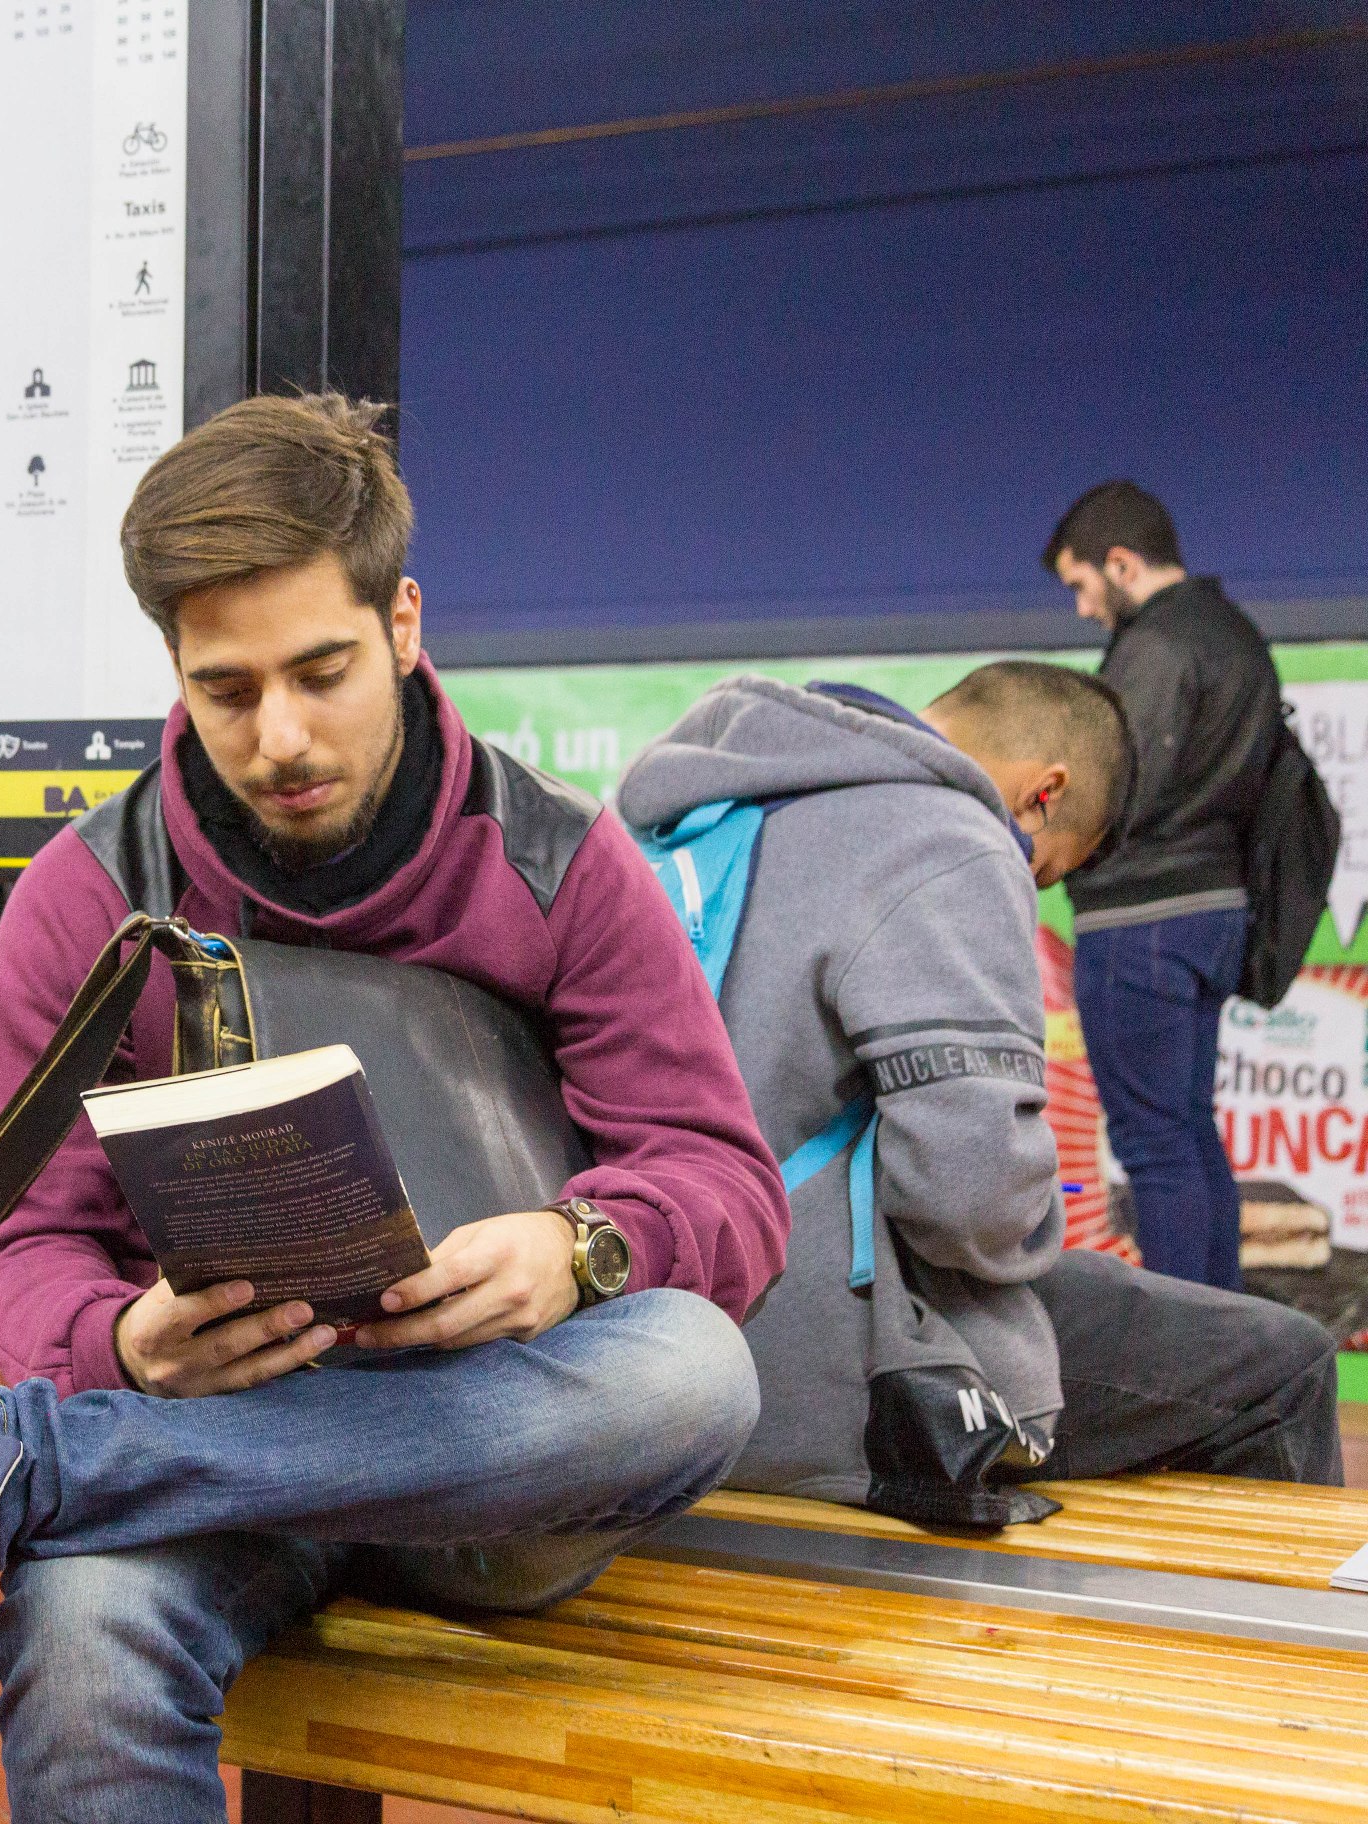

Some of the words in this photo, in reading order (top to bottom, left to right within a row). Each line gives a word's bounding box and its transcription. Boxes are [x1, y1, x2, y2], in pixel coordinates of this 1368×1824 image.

[124, 198, 167, 218] Taxis
[874, 1045, 993, 1092] NUCLEAR
[184, 1150, 207, 1162] EN
[212, 1147, 232, 1160] LA
[236, 1132, 303, 1155] CIUDAD
[240, 1123, 294, 1143] MOURAD
[182, 1159, 202, 1172] DE
[209, 1154, 246, 1168] ORO
[266, 1140, 313, 1160] PLATA
